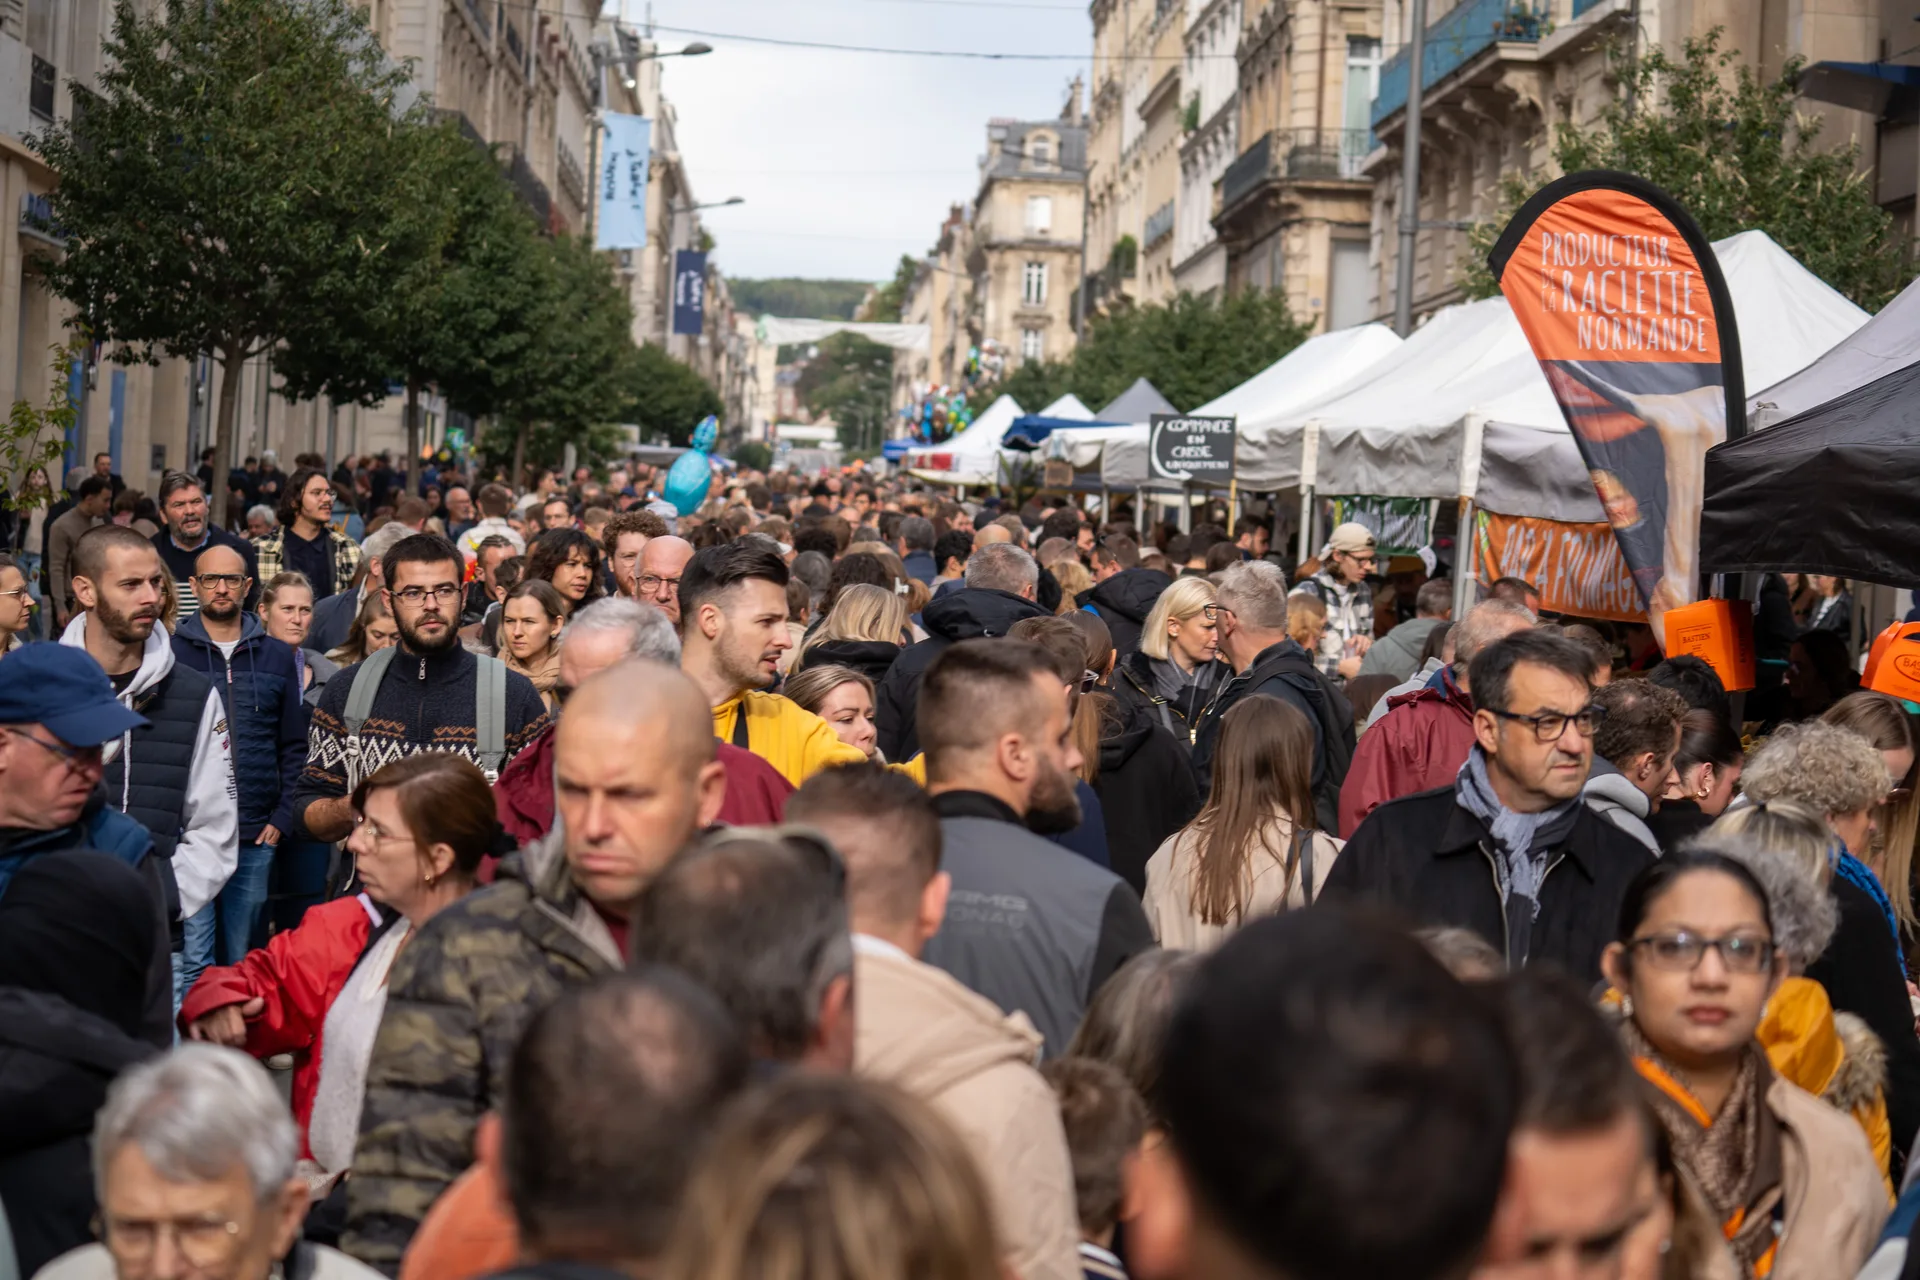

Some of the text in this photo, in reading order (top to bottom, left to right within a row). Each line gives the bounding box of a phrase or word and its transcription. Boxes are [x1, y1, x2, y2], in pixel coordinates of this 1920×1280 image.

[1541, 231, 1672, 268] PRODUCTEUR
[1541, 268, 1557, 290] DE
[1562, 269, 1696, 315] RACLETTE
[1541, 291, 1557, 313] LA
[1577, 315, 1707, 352] NORMANDE
[1186, 434, 1206, 445] EN
